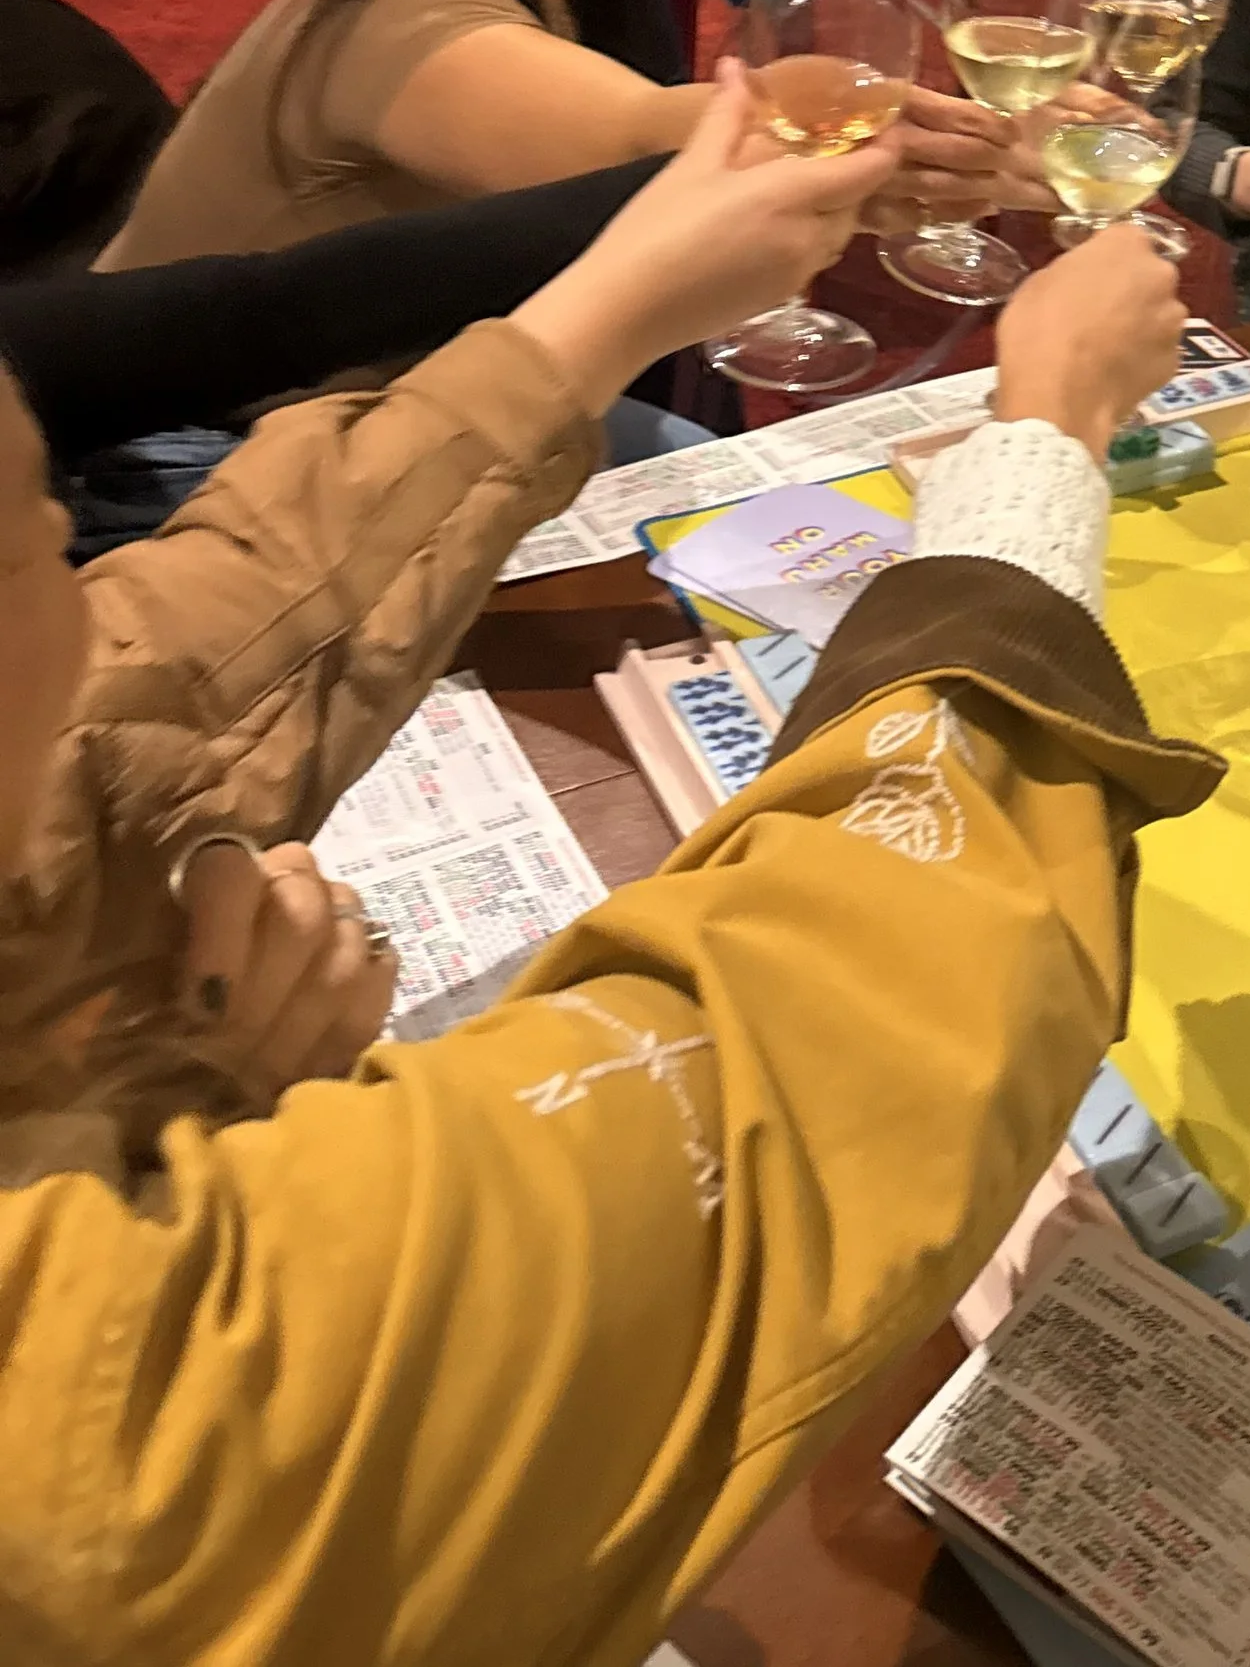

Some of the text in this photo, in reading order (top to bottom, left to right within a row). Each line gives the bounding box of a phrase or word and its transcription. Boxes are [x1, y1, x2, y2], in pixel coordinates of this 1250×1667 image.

[768, 525, 826, 553] ON
[779, 530, 879, 583] MAHJ
[814, 549, 908, 599] YOUR
